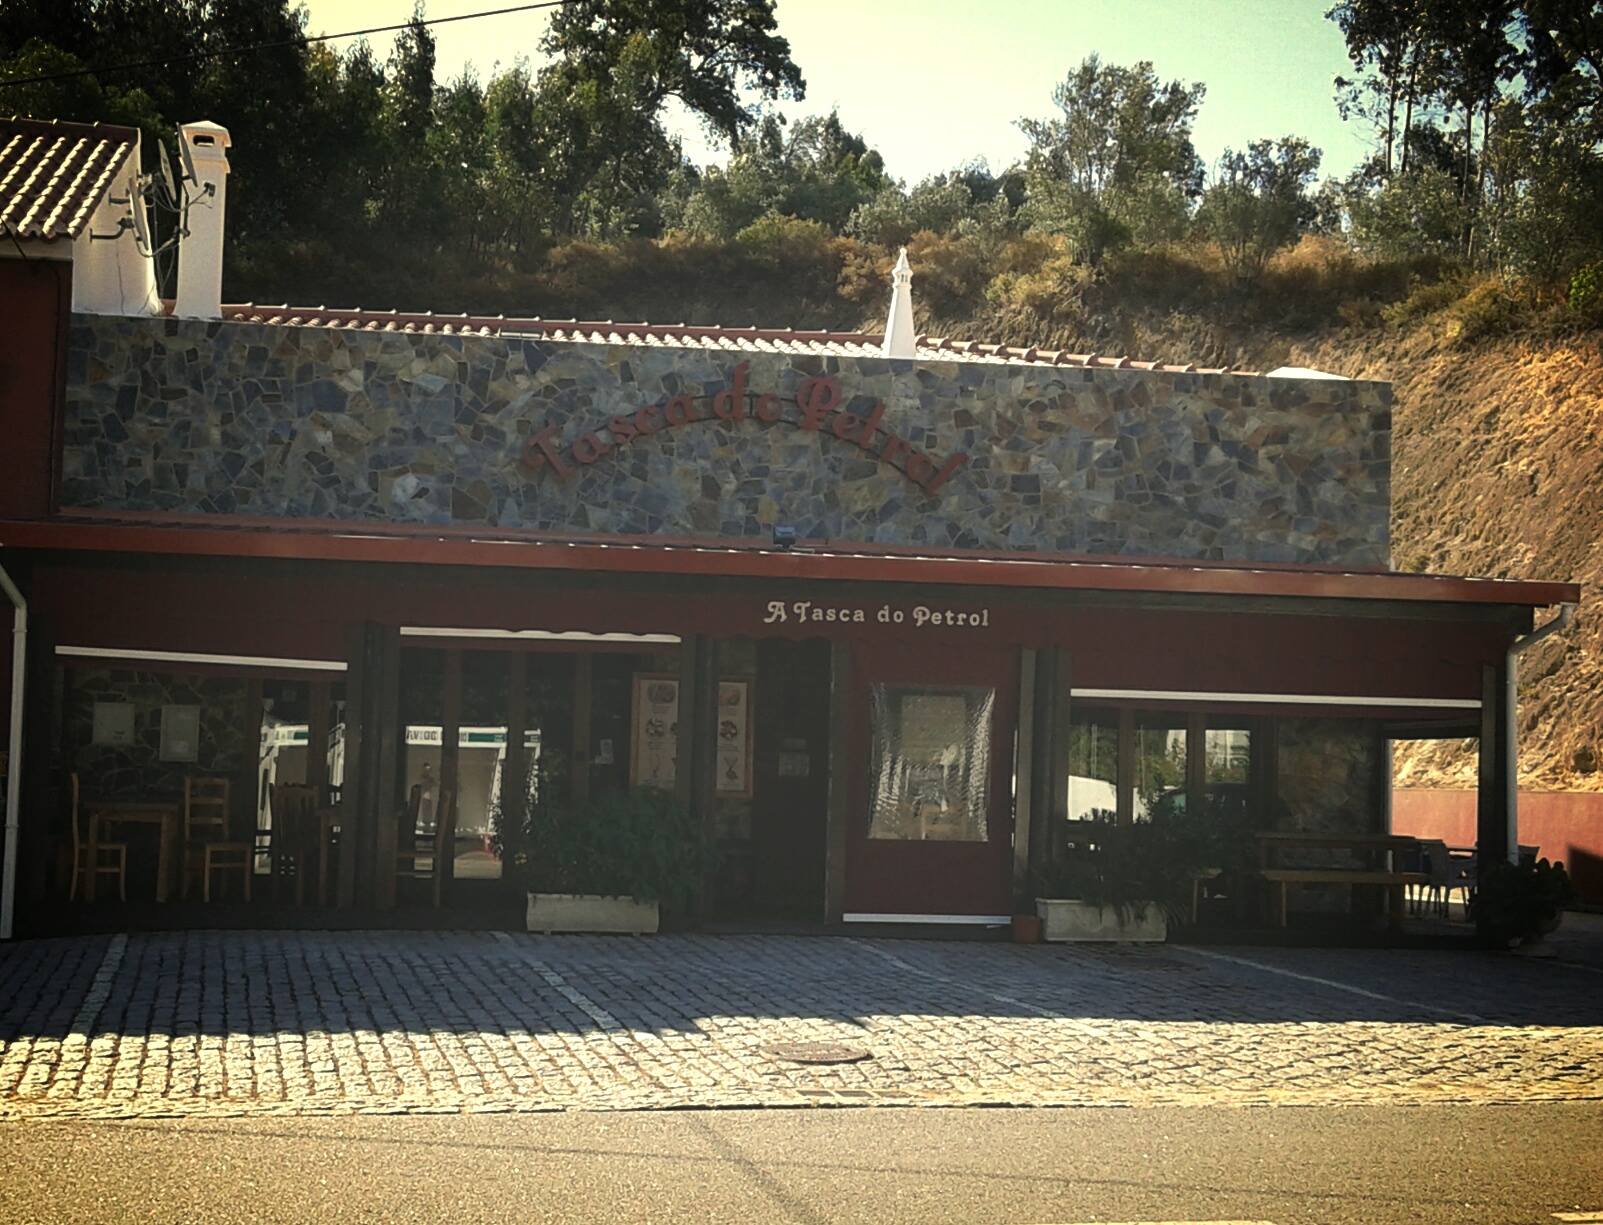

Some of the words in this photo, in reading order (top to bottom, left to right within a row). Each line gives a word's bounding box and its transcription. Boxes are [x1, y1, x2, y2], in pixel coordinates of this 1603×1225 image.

[521, 390, 699, 481] Tasca
[712, 360, 783, 422] do
[763, 600, 788, 624] A
[792, 601, 866, 624] Tasca
[876, 604, 905, 624] do
[912, 605, 990, 628] Petrol
